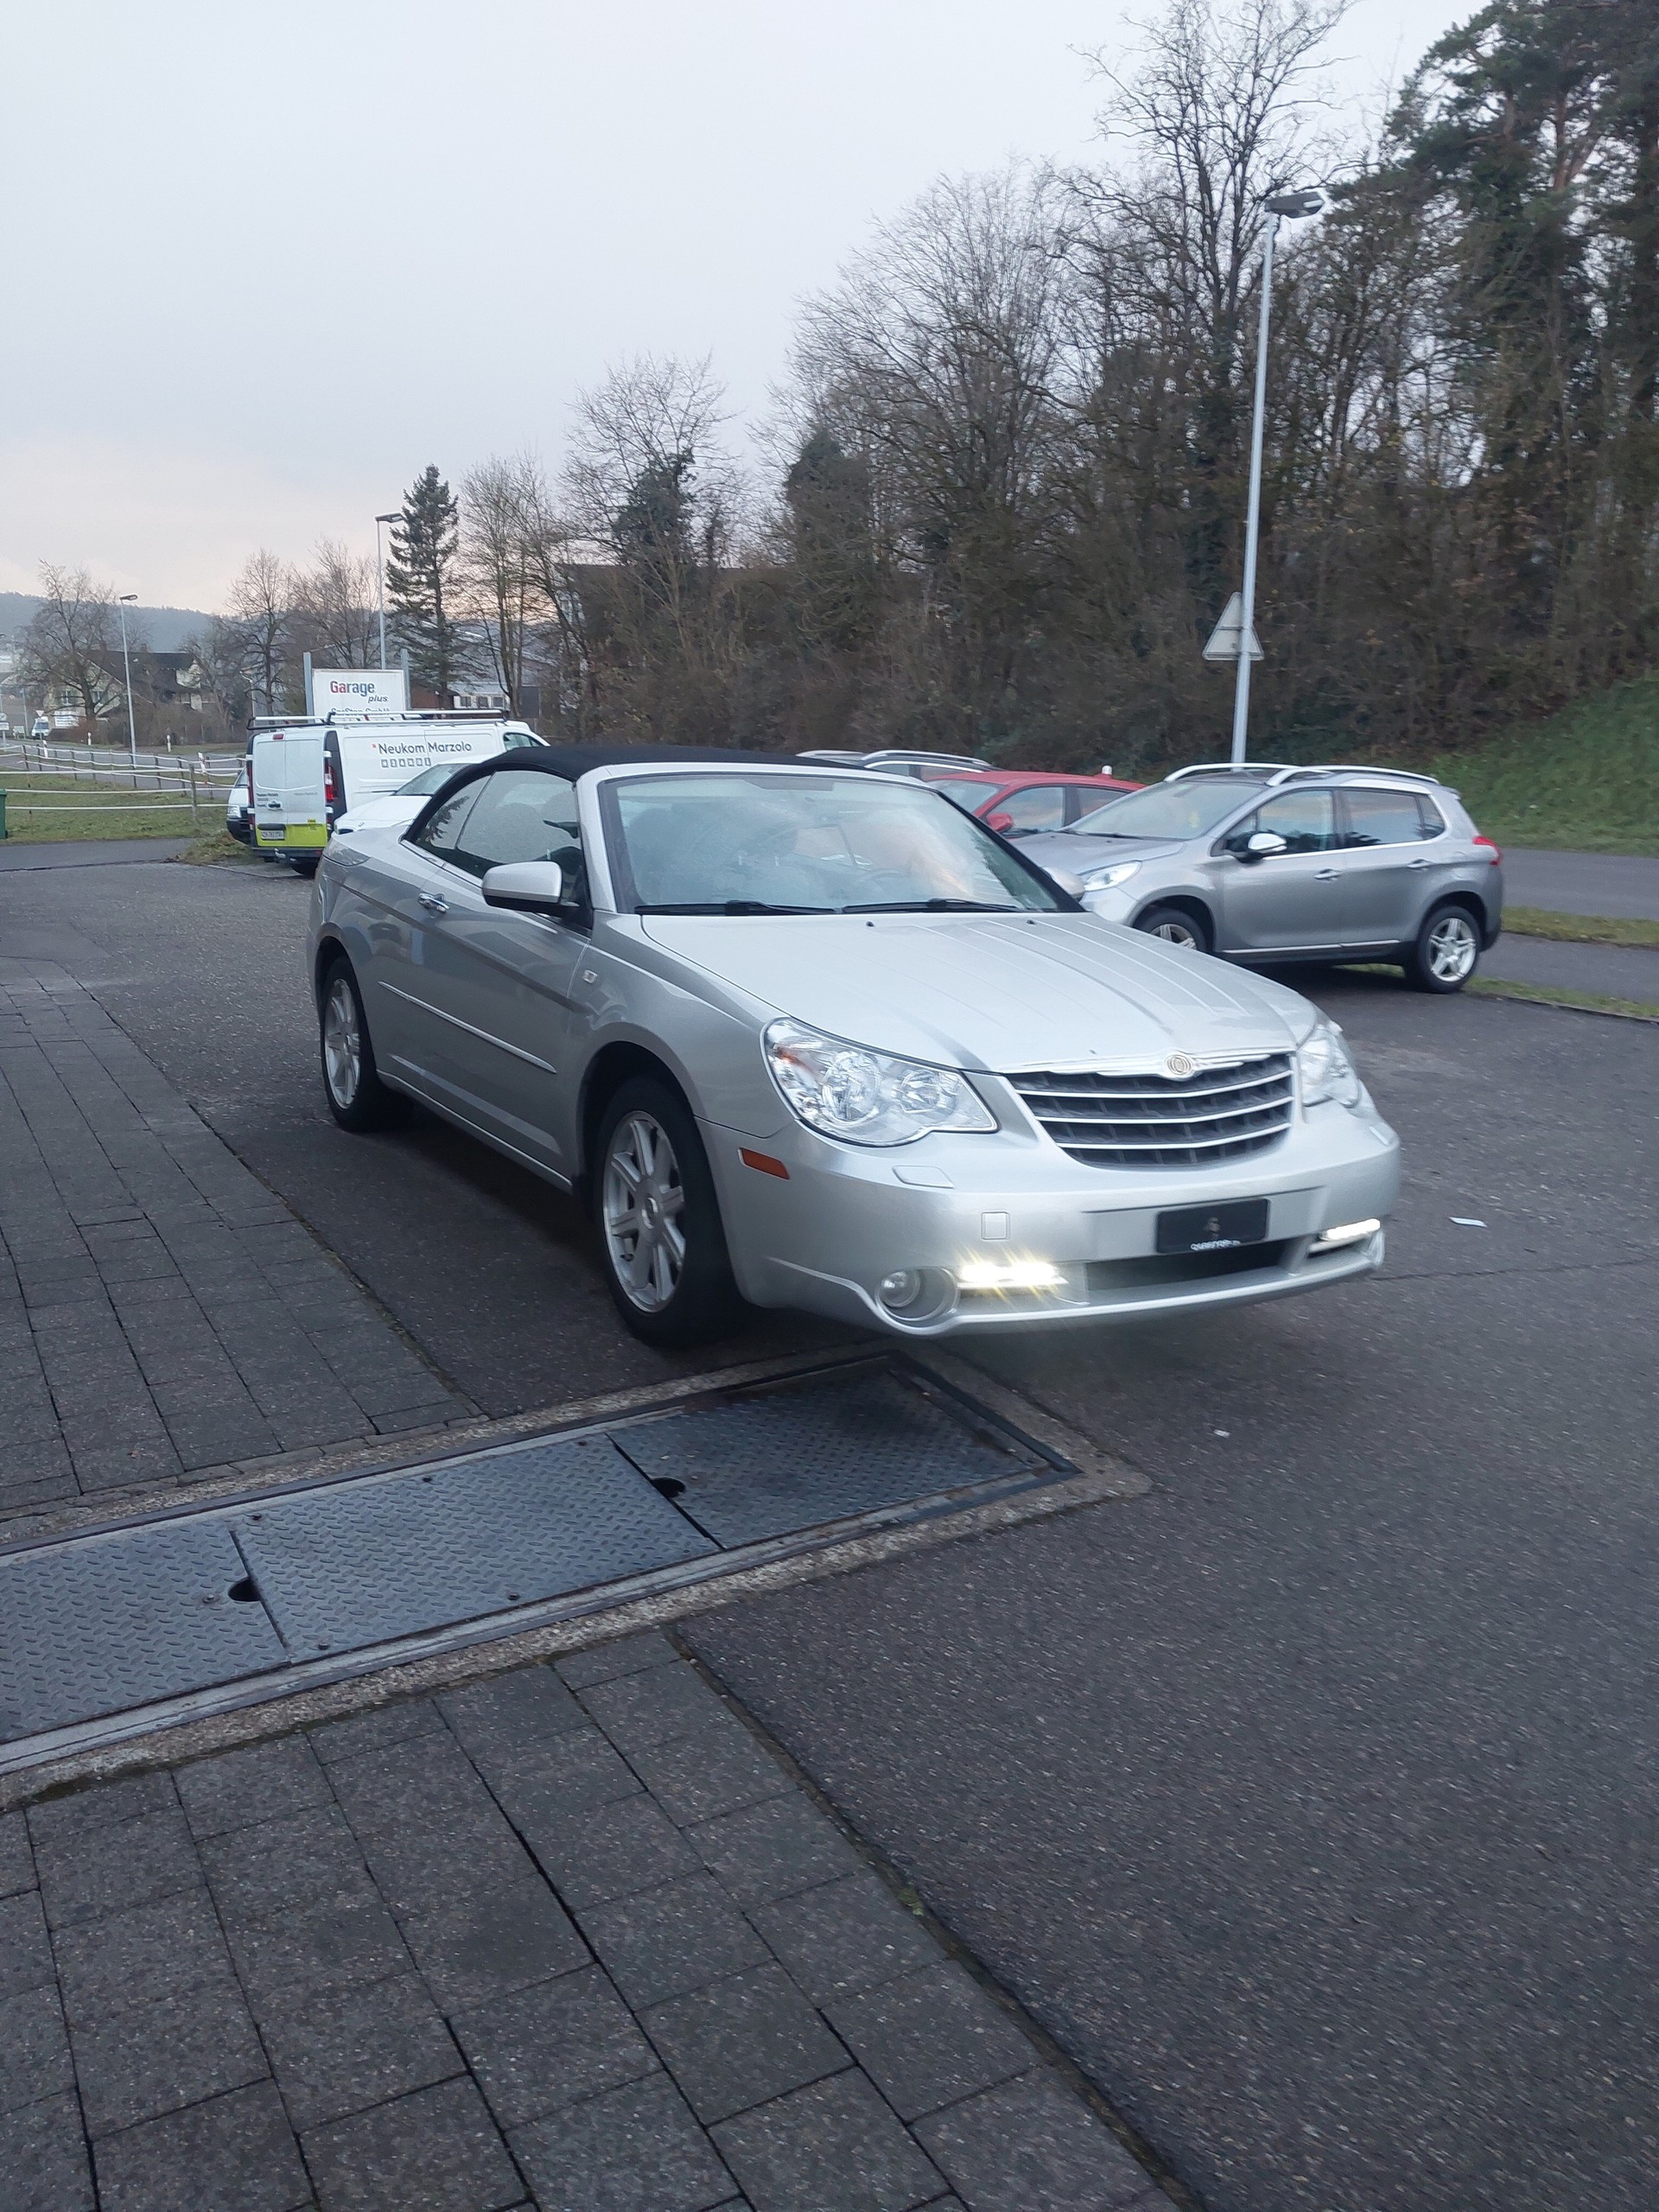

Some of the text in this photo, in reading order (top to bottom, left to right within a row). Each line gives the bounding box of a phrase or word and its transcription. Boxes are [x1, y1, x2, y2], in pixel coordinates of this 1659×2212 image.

[330, 681, 374, 696] Garage
[368, 695, 388, 703] plus
[378, 741, 472, 754] Neukom Marzolo
